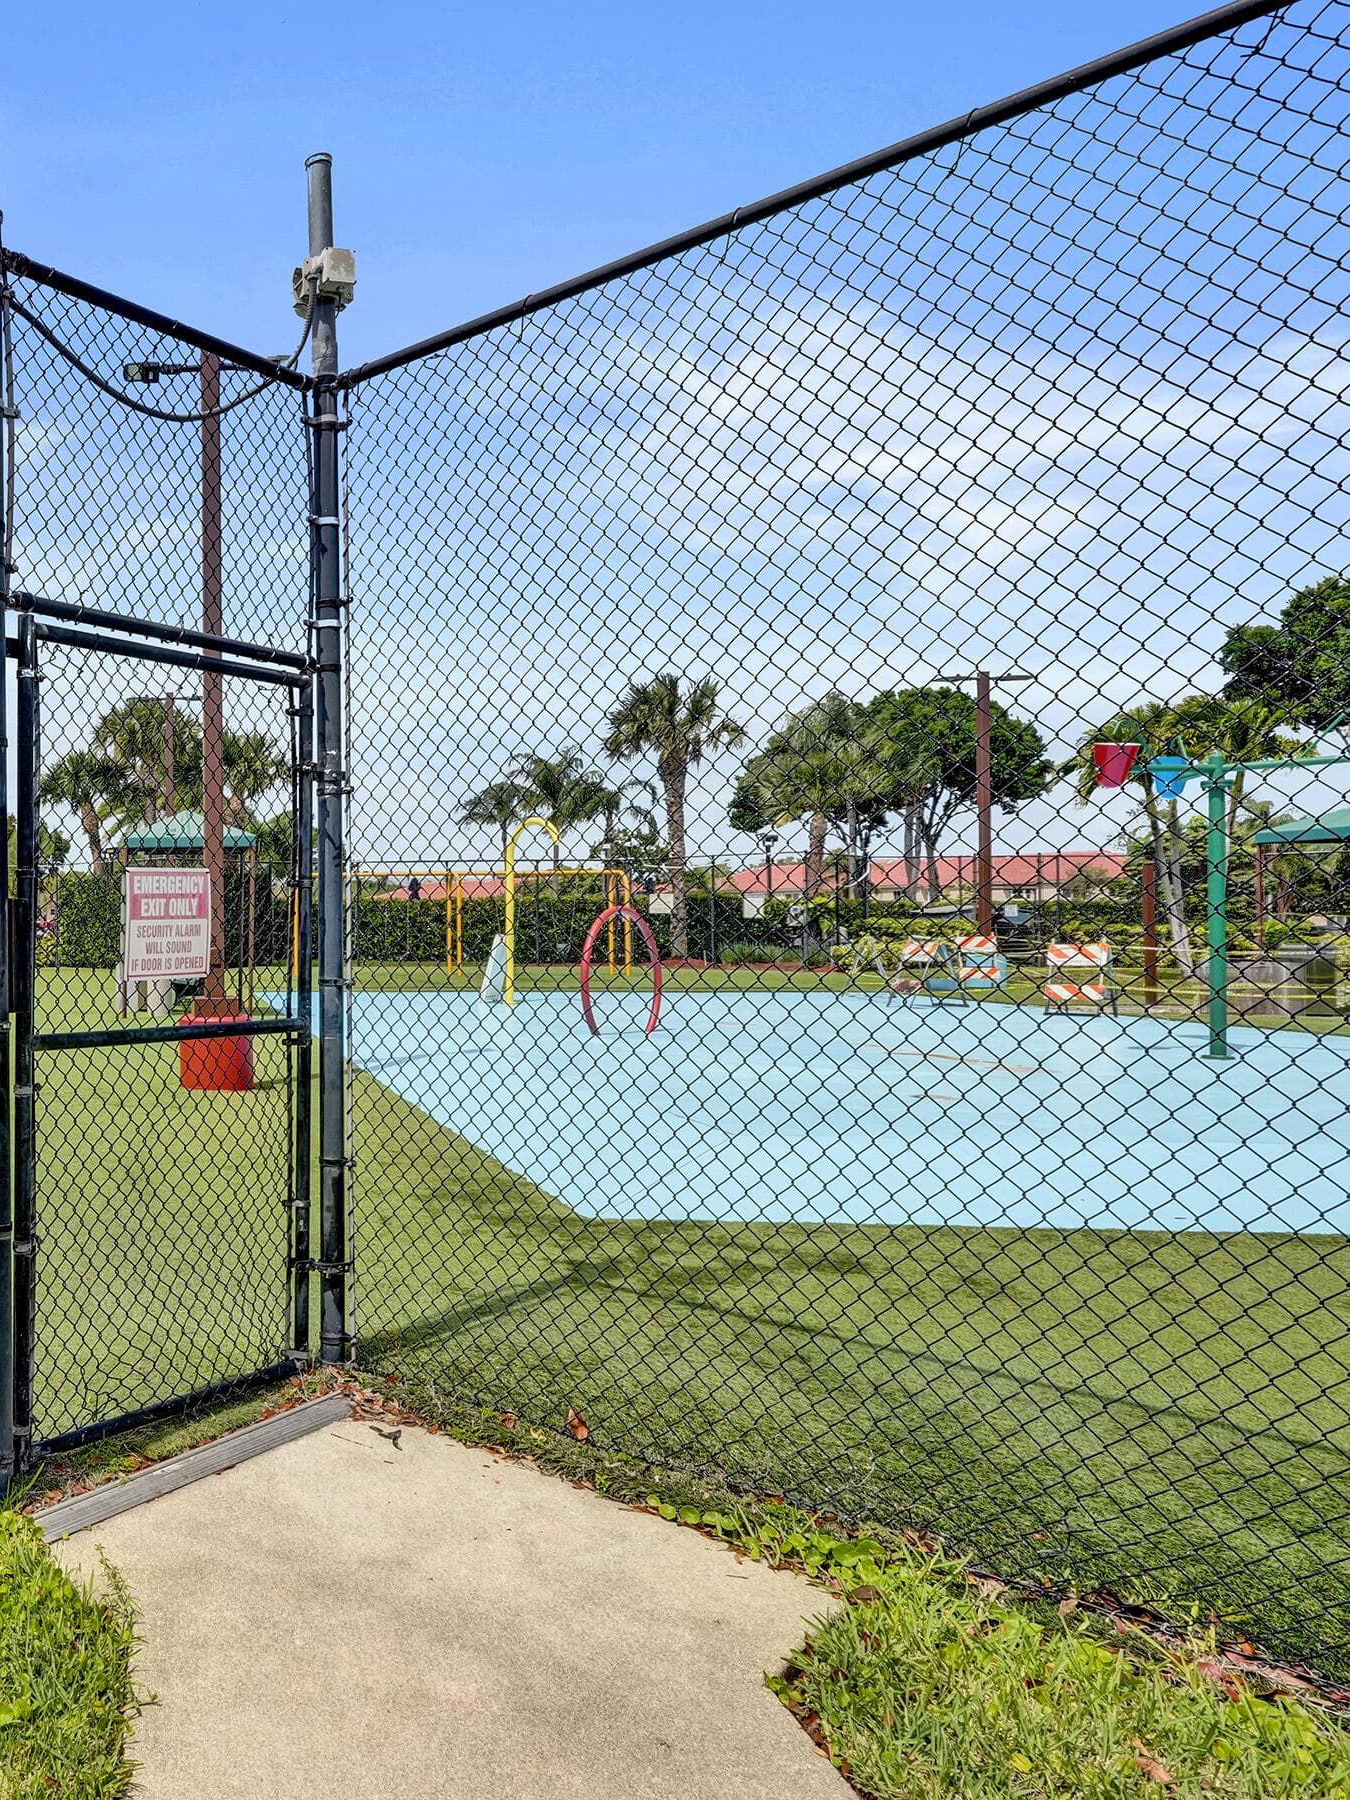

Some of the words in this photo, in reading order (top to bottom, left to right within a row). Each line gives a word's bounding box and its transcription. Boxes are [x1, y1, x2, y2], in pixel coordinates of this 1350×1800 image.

[133, 876, 205, 895] EMERGENCY
[141, 898, 167, 917] EXIT
[169, 897, 199, 916] ONLY
[137, 925, 173, 938] SECURITY
[175, 924, 202, 937] ALARM
[145, 942, 164, 955] WILL
[165, 940, 192, 954] SOUND
[131, 959, 139, 972] IF
[141, 958, 163, 971] DOOR
[164, 957, 172, 970] IS
[174, 956, 204, 970] OPENED
